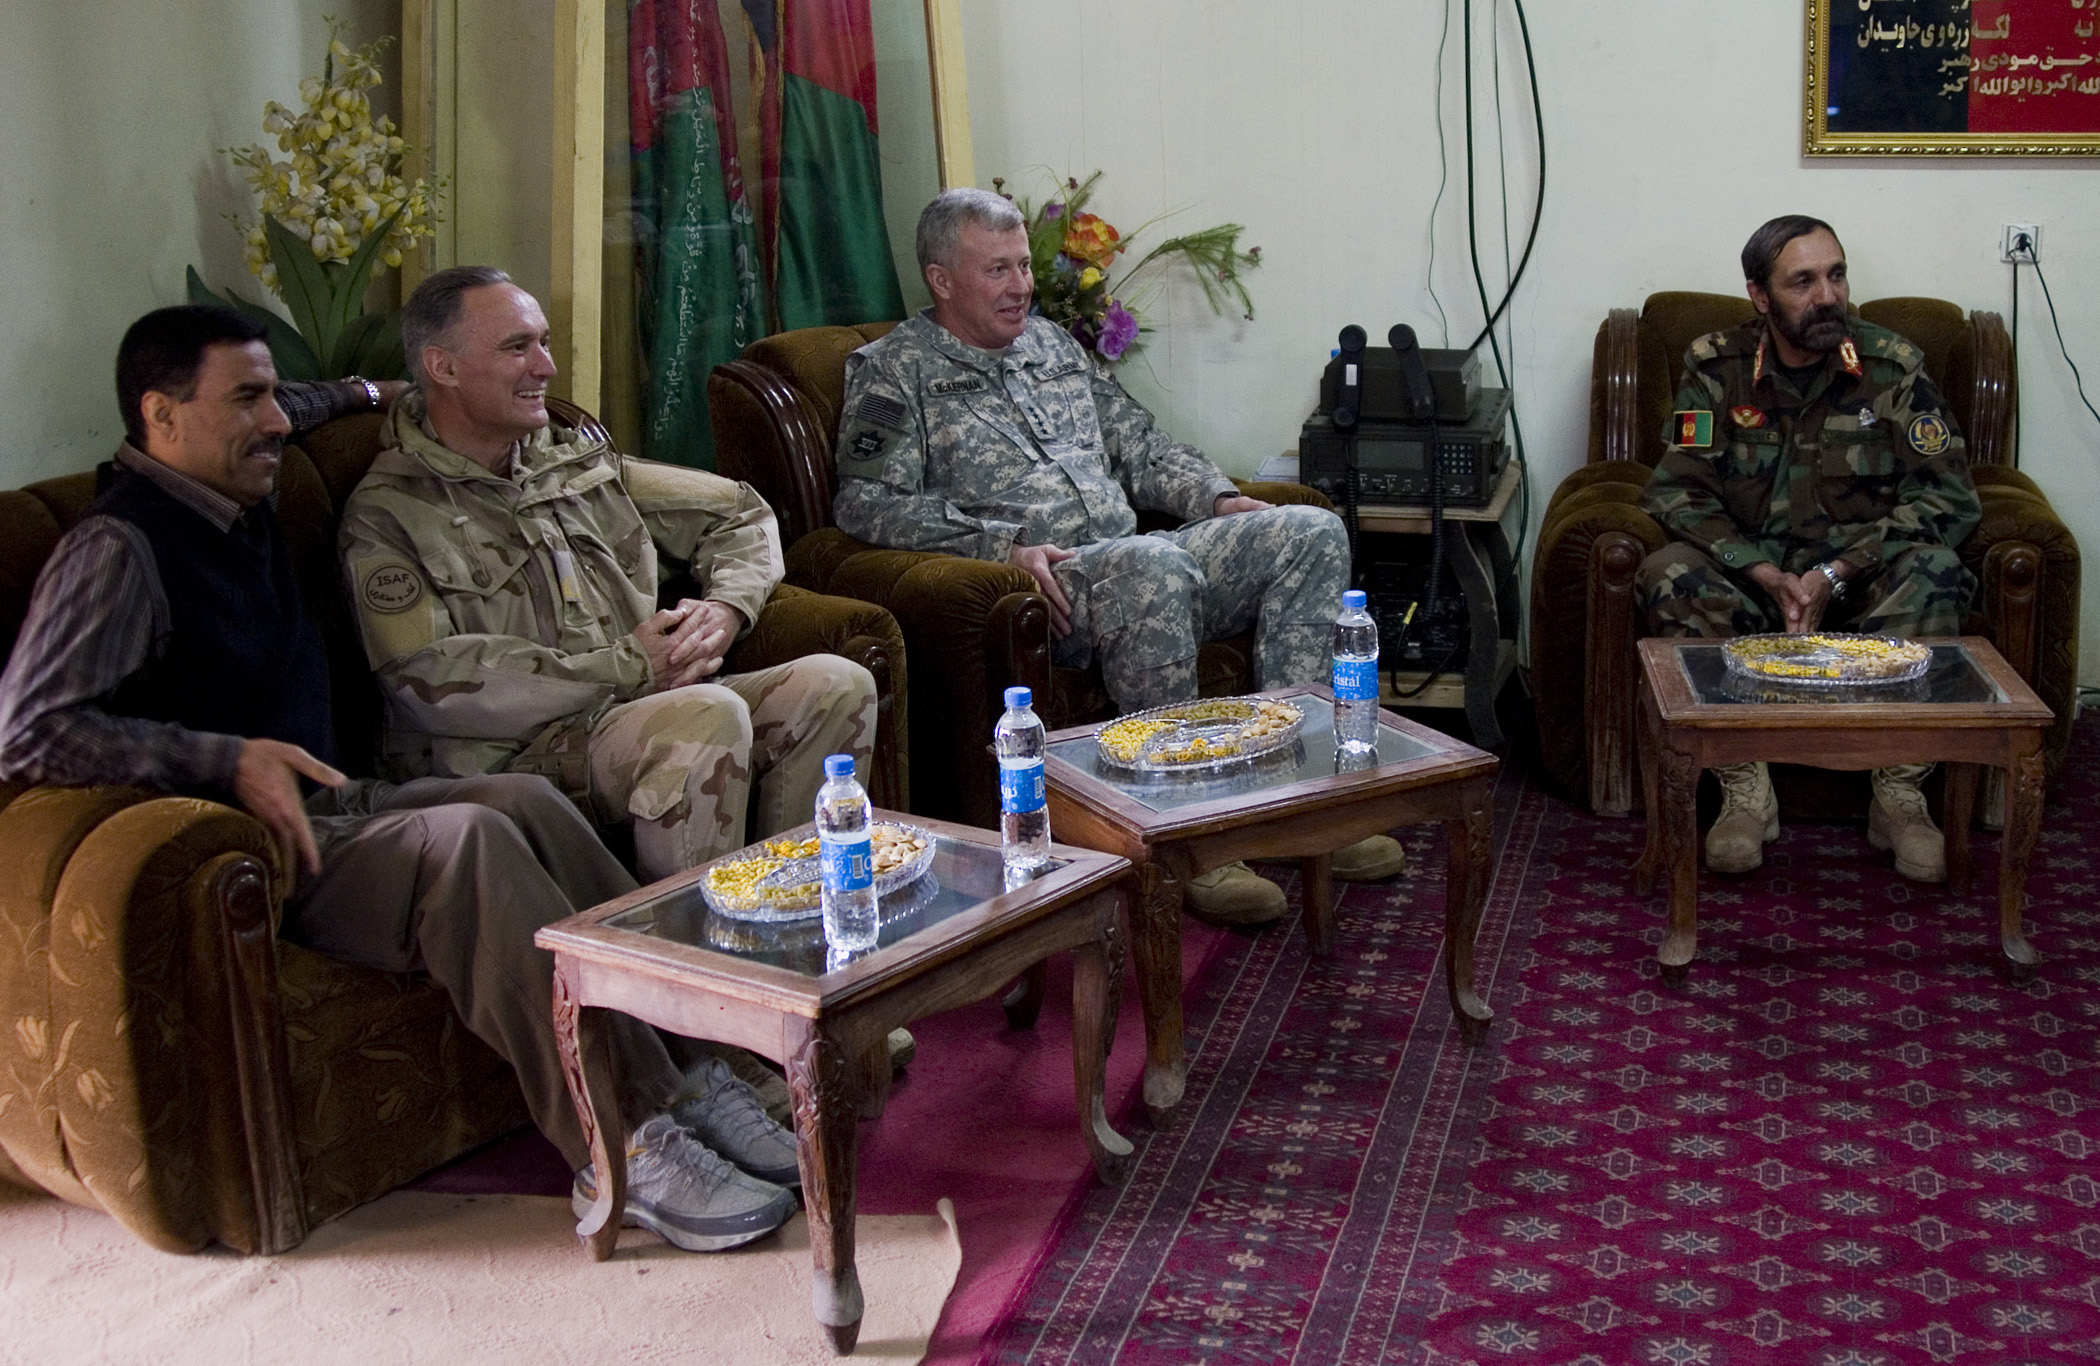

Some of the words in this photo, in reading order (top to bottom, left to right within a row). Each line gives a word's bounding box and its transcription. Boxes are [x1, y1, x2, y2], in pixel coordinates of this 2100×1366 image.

[1938, 54, 1980, 76] رهبر
[2039, 46, 2093, 71] حق
[1980, 76, 2009, 96] الله
[2078, 76, 2100, 95] لله
[376, 573, 409, 587] ISAF
[1333, 673, 1360, 687] ristal
